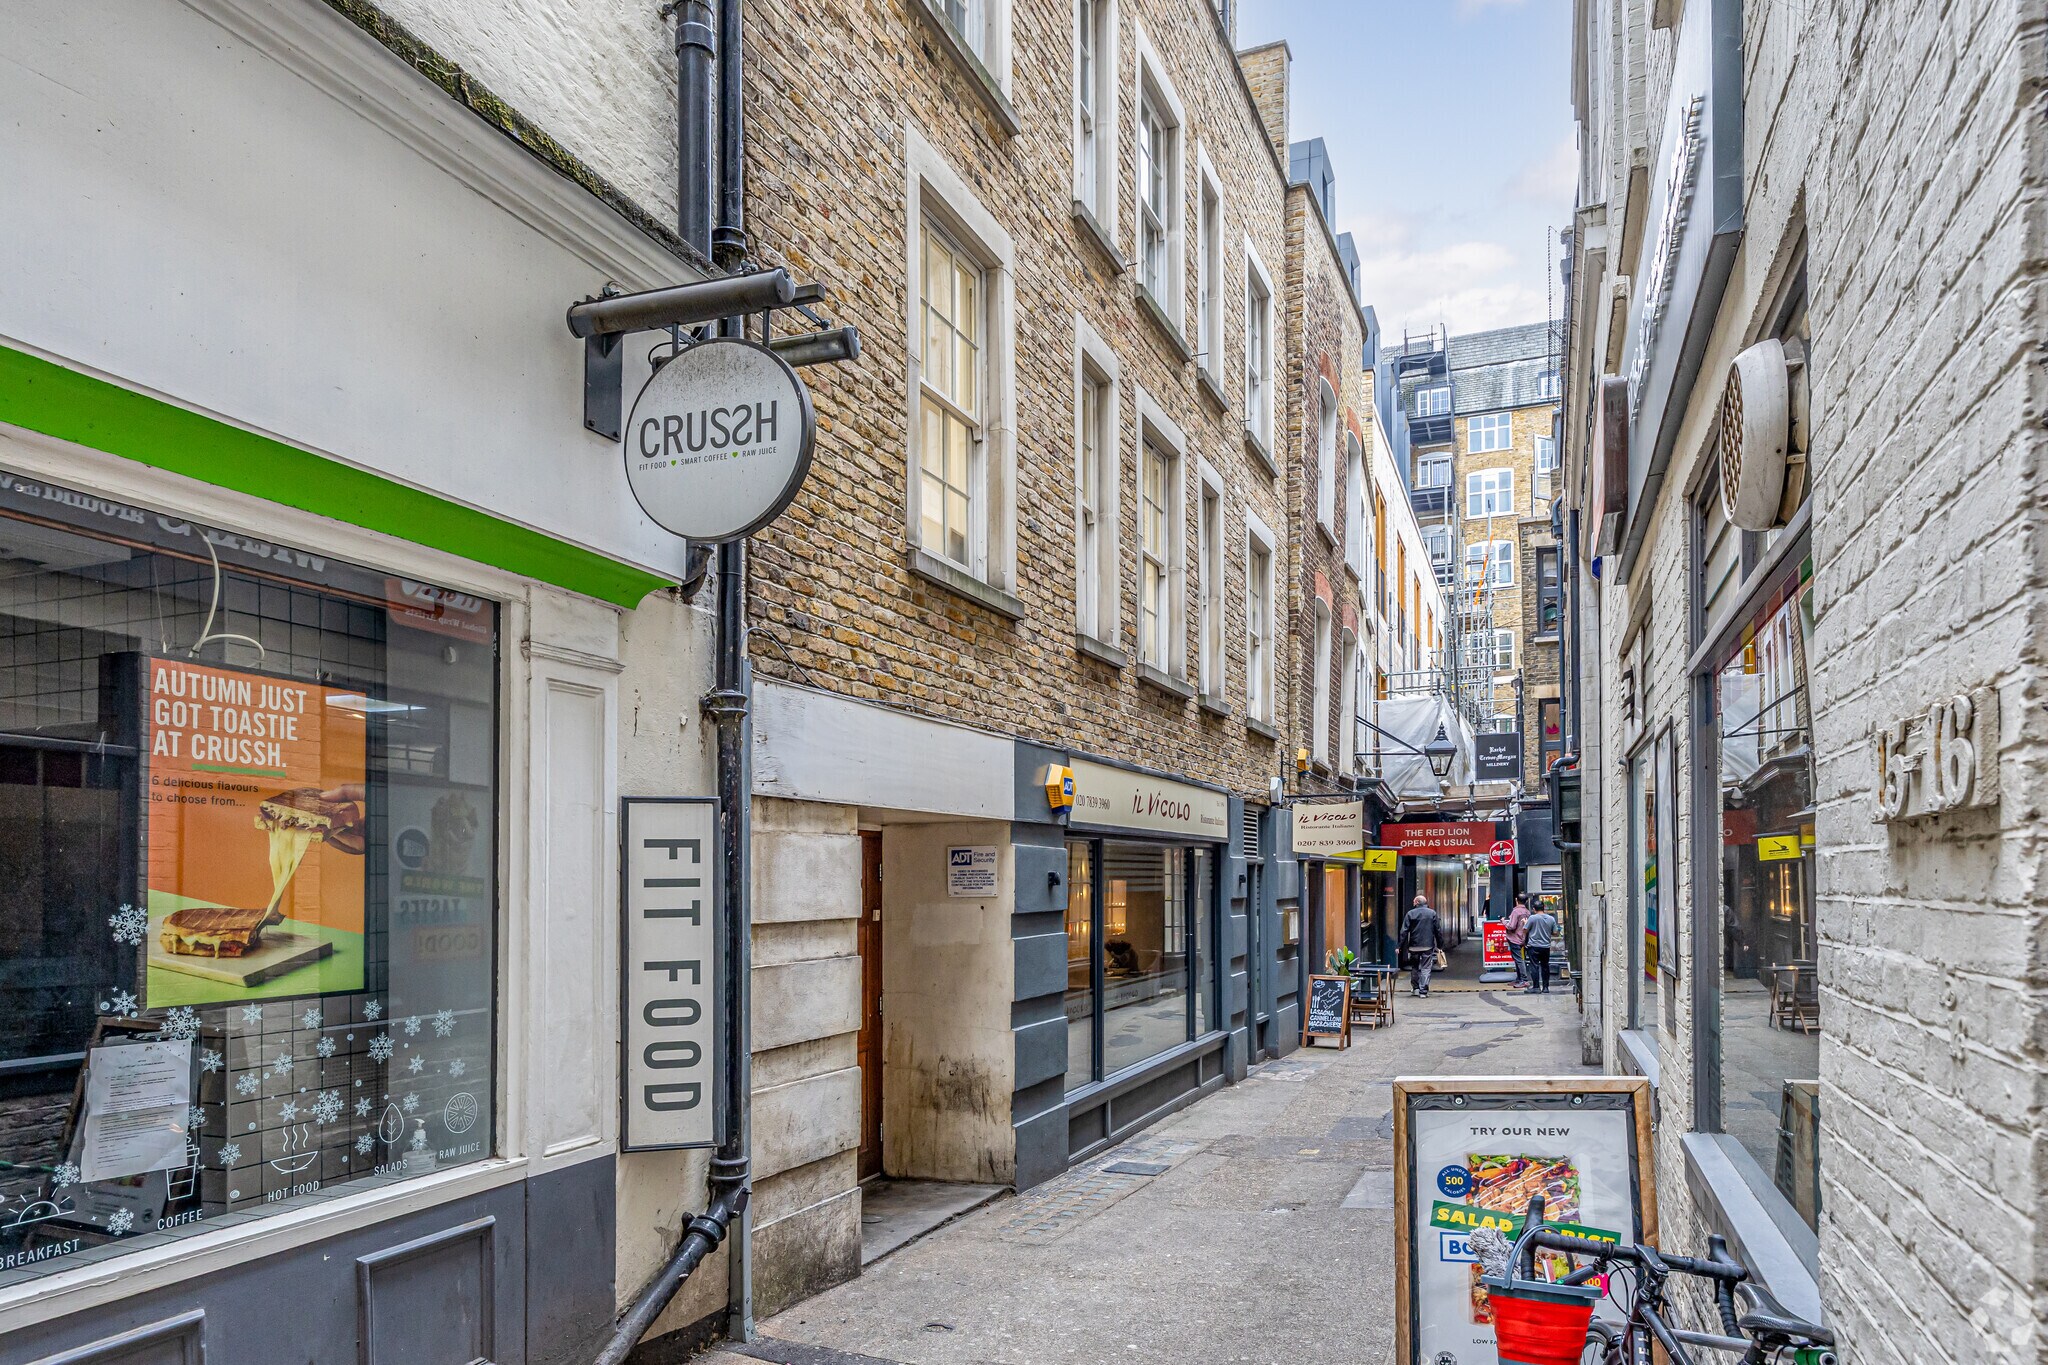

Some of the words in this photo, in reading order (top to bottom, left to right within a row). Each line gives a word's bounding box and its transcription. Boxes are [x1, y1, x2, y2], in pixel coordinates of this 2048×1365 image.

[640, 400, 777, 458] CRUSSH
[681, 457, 701, 465] SMART
[704, 453, 727, 462] COFFEE
[759, 447, 776, 455] JUICE
[154, 668, 251, 706] AUTUMN
[259, 685, 307, 714] JUST
[155, 699, 202, 729] GOT
[210, 706, 298, 741] TOASTIE
[153, 730, 182, 757] AT
[191, 734, 286, 768] CRUSSH.
[152, 776, 159, 785] 6
[164, 777, 213, 789] delicious
[218, 781, 259, 792] flavours
[1064, 781, 1073, 792] ADT
[152, 792, 162, 801] to
[167, 794, 206, 804] choose
[211, 796, 245, 806] from...
[1076, 794, 1085, 806] 020
[1087, 796, 1098, 808] 7839
[1099, 798, 1110, 809] 3960
[952, 852, 972, 863] ADT
[643, 839, 701, 926] FIT
[643, 960, 701, 1112] FOOD
[1502, 1128, 1531, 1136] OUR
[1537, 1128, 1570, 1136] NEW
[439, 1148, 456, 1159] RAW
[459, 1142, 480, 1155] JUICE
[374, 1159, 408, 1176] SALADS
[1451, 1168, 1467, 1177] UNDER
[1446, 1176, 1464, 1185] 500
[268, 1188, 289, 1202] HOT
[293, 1180, 319, 1196] FOOD
[157, 1209, 203, 1231] COFFEE
[1437, 1208, 1513, 1233] SALAD
[0, 1238, 80, 1270] BREAKFAST
